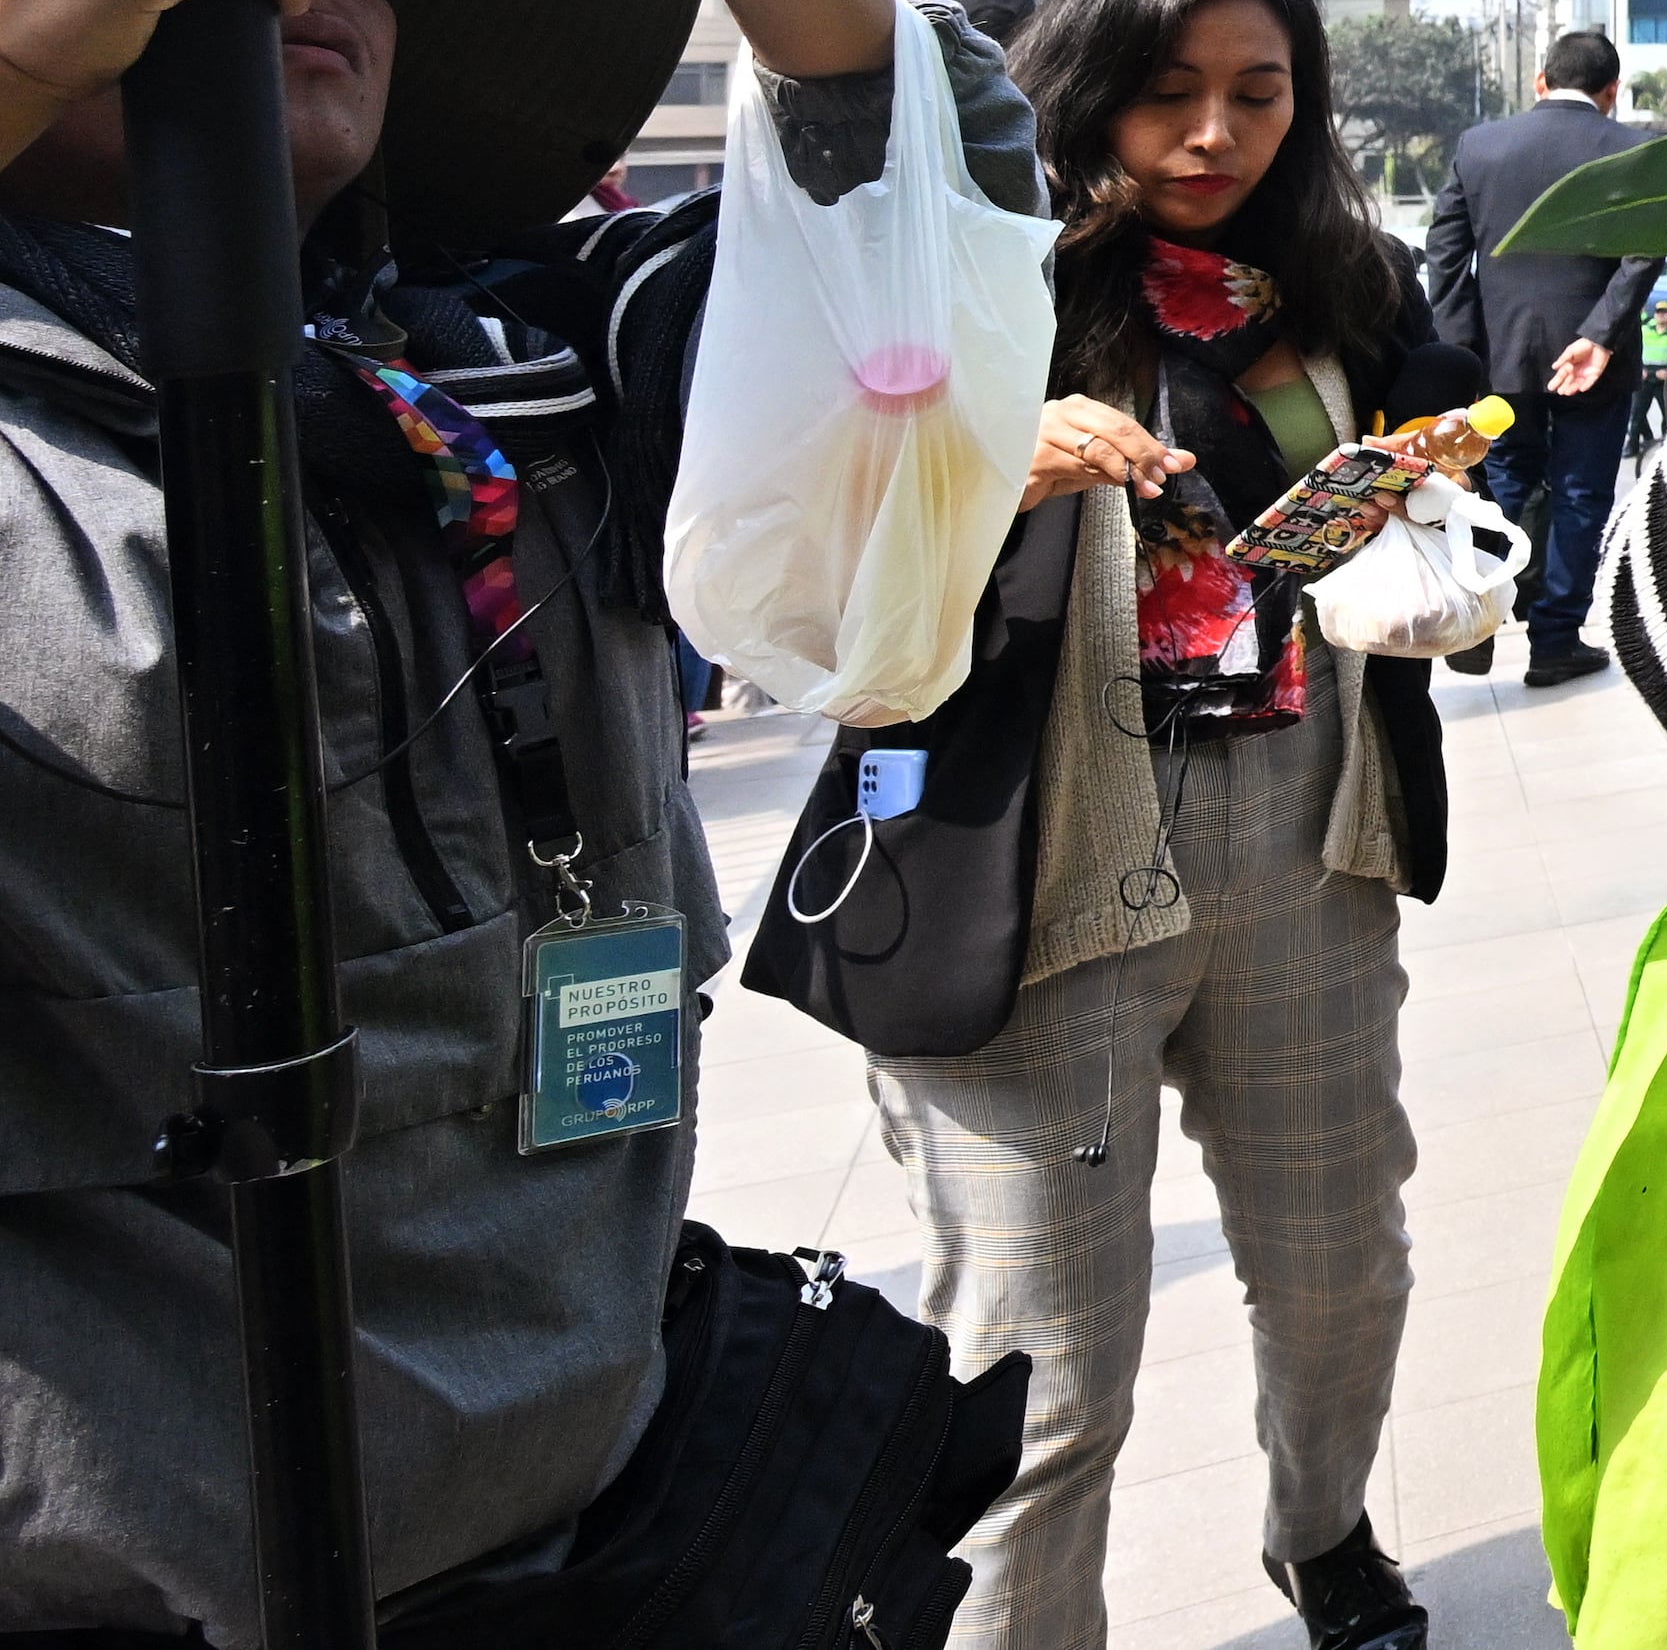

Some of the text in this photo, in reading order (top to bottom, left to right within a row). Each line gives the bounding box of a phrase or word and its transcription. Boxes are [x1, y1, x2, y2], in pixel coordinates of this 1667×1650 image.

[569, 979, 651, 1003] NUESTRO
[568, 993, 668, 1019] PROPÓSITO
[567, 1022, 643, 1045] PROMOVER
[566, 1033, 662, 1059] EL PROGRESO
[566, 1056, 614, 1074] DE LOS
[566, 1064, 642, 1087] PERUANOS
[627, 1100, 656, 1114] RPP
